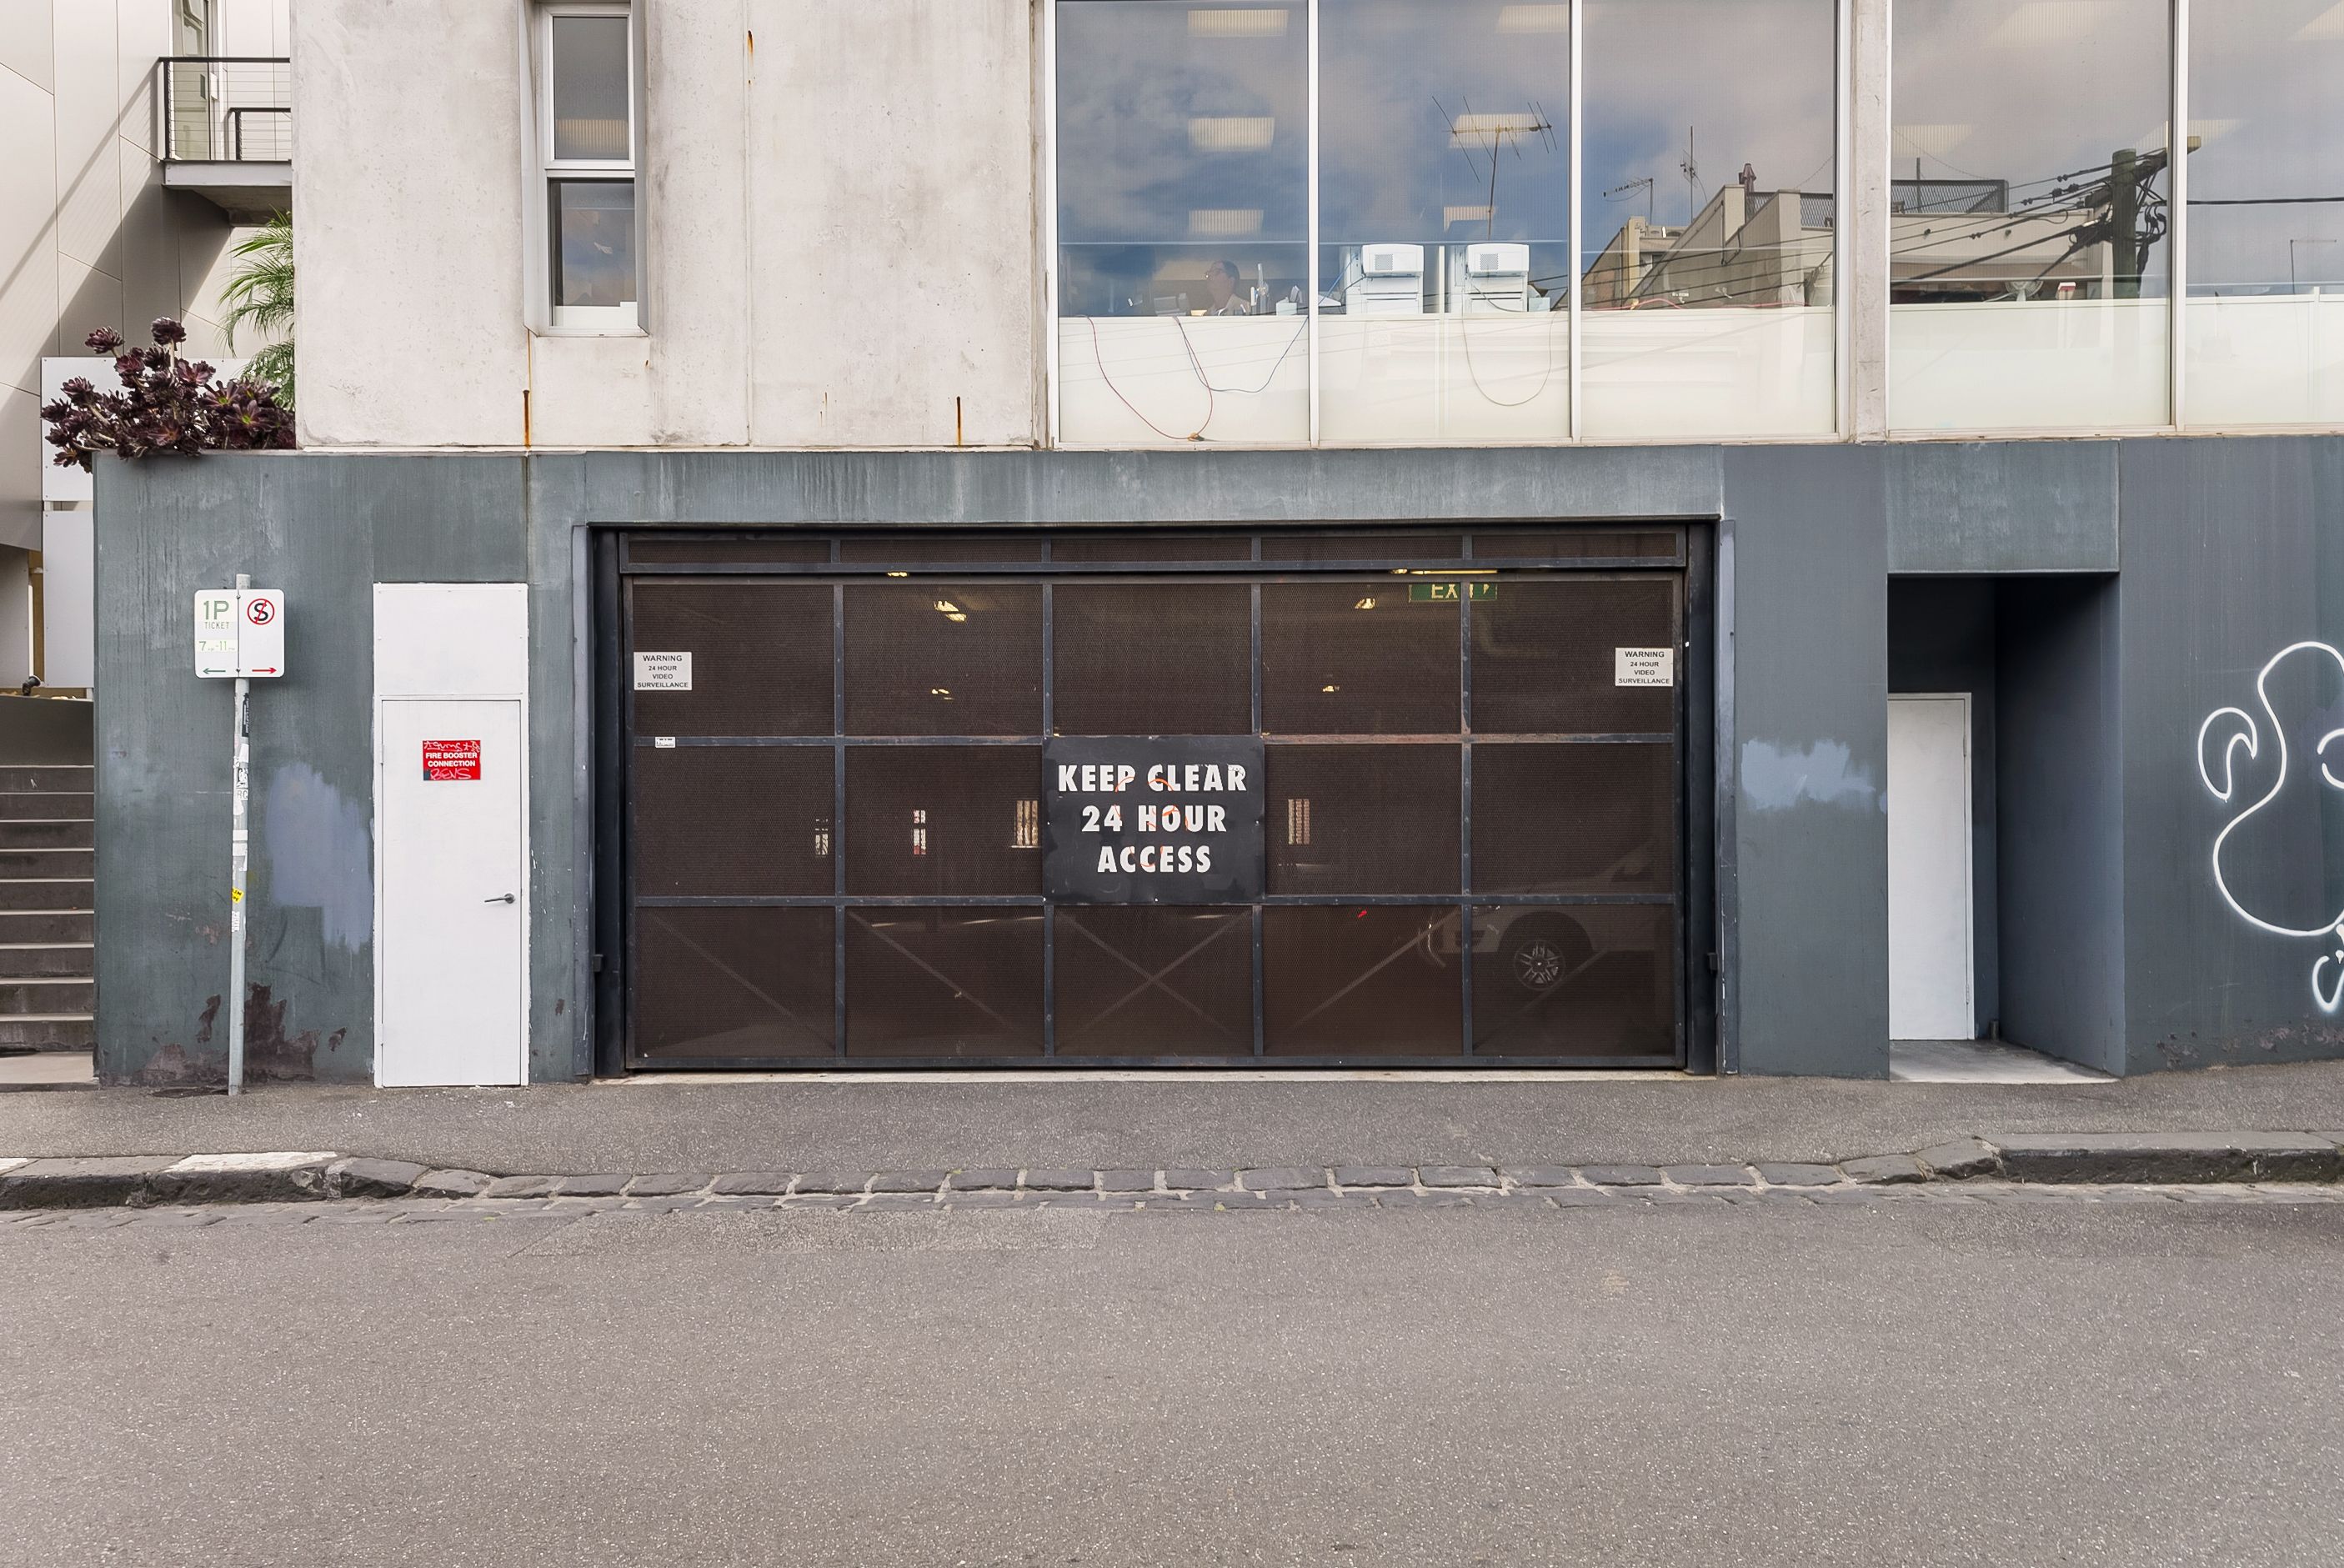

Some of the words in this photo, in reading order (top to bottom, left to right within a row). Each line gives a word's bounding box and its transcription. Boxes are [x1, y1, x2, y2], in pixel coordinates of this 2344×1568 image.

[1431, 584, 1474, 599] EX
[203, 600, 229, 620] 1P
[204, 621, 229, 629] TICKET
[1058, 764, 1136, 792] KEEP
[1146, 764, 1247, 792] CLEAR
[1081, 804, 1123, 832] 24
[1138, 804, 1227, 832] HOUR
[1097, 845, 1211, 873] ACCESS
